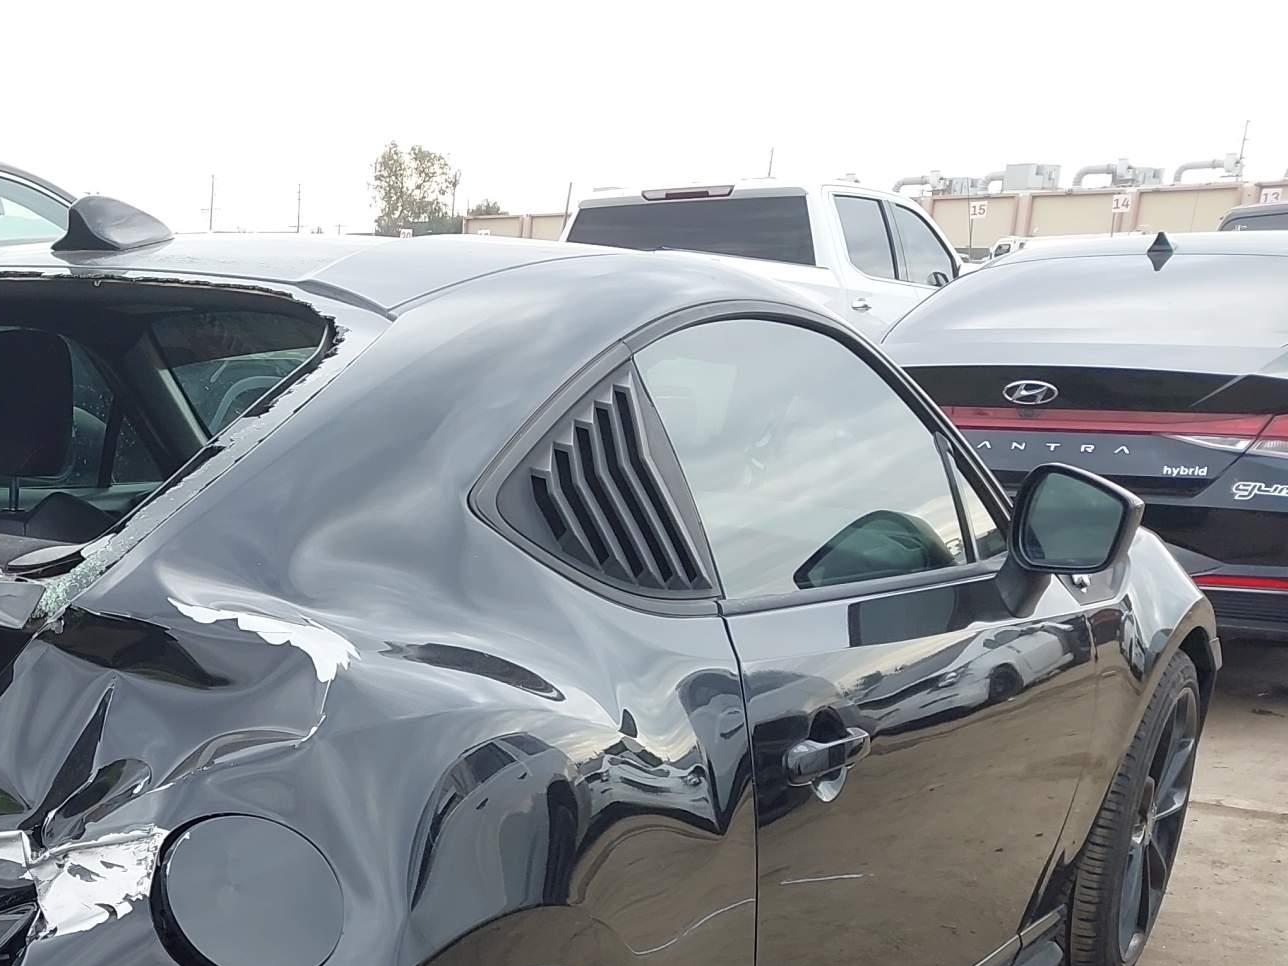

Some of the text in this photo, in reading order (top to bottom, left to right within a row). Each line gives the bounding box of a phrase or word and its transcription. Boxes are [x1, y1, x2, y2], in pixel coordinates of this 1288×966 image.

[1113, 198, 1130, 210] 14
[971, 205, 986, 216] 15
[976, 440, 1131, 454] ANTRA
[1162, 465, 1208, 477] hybrid
